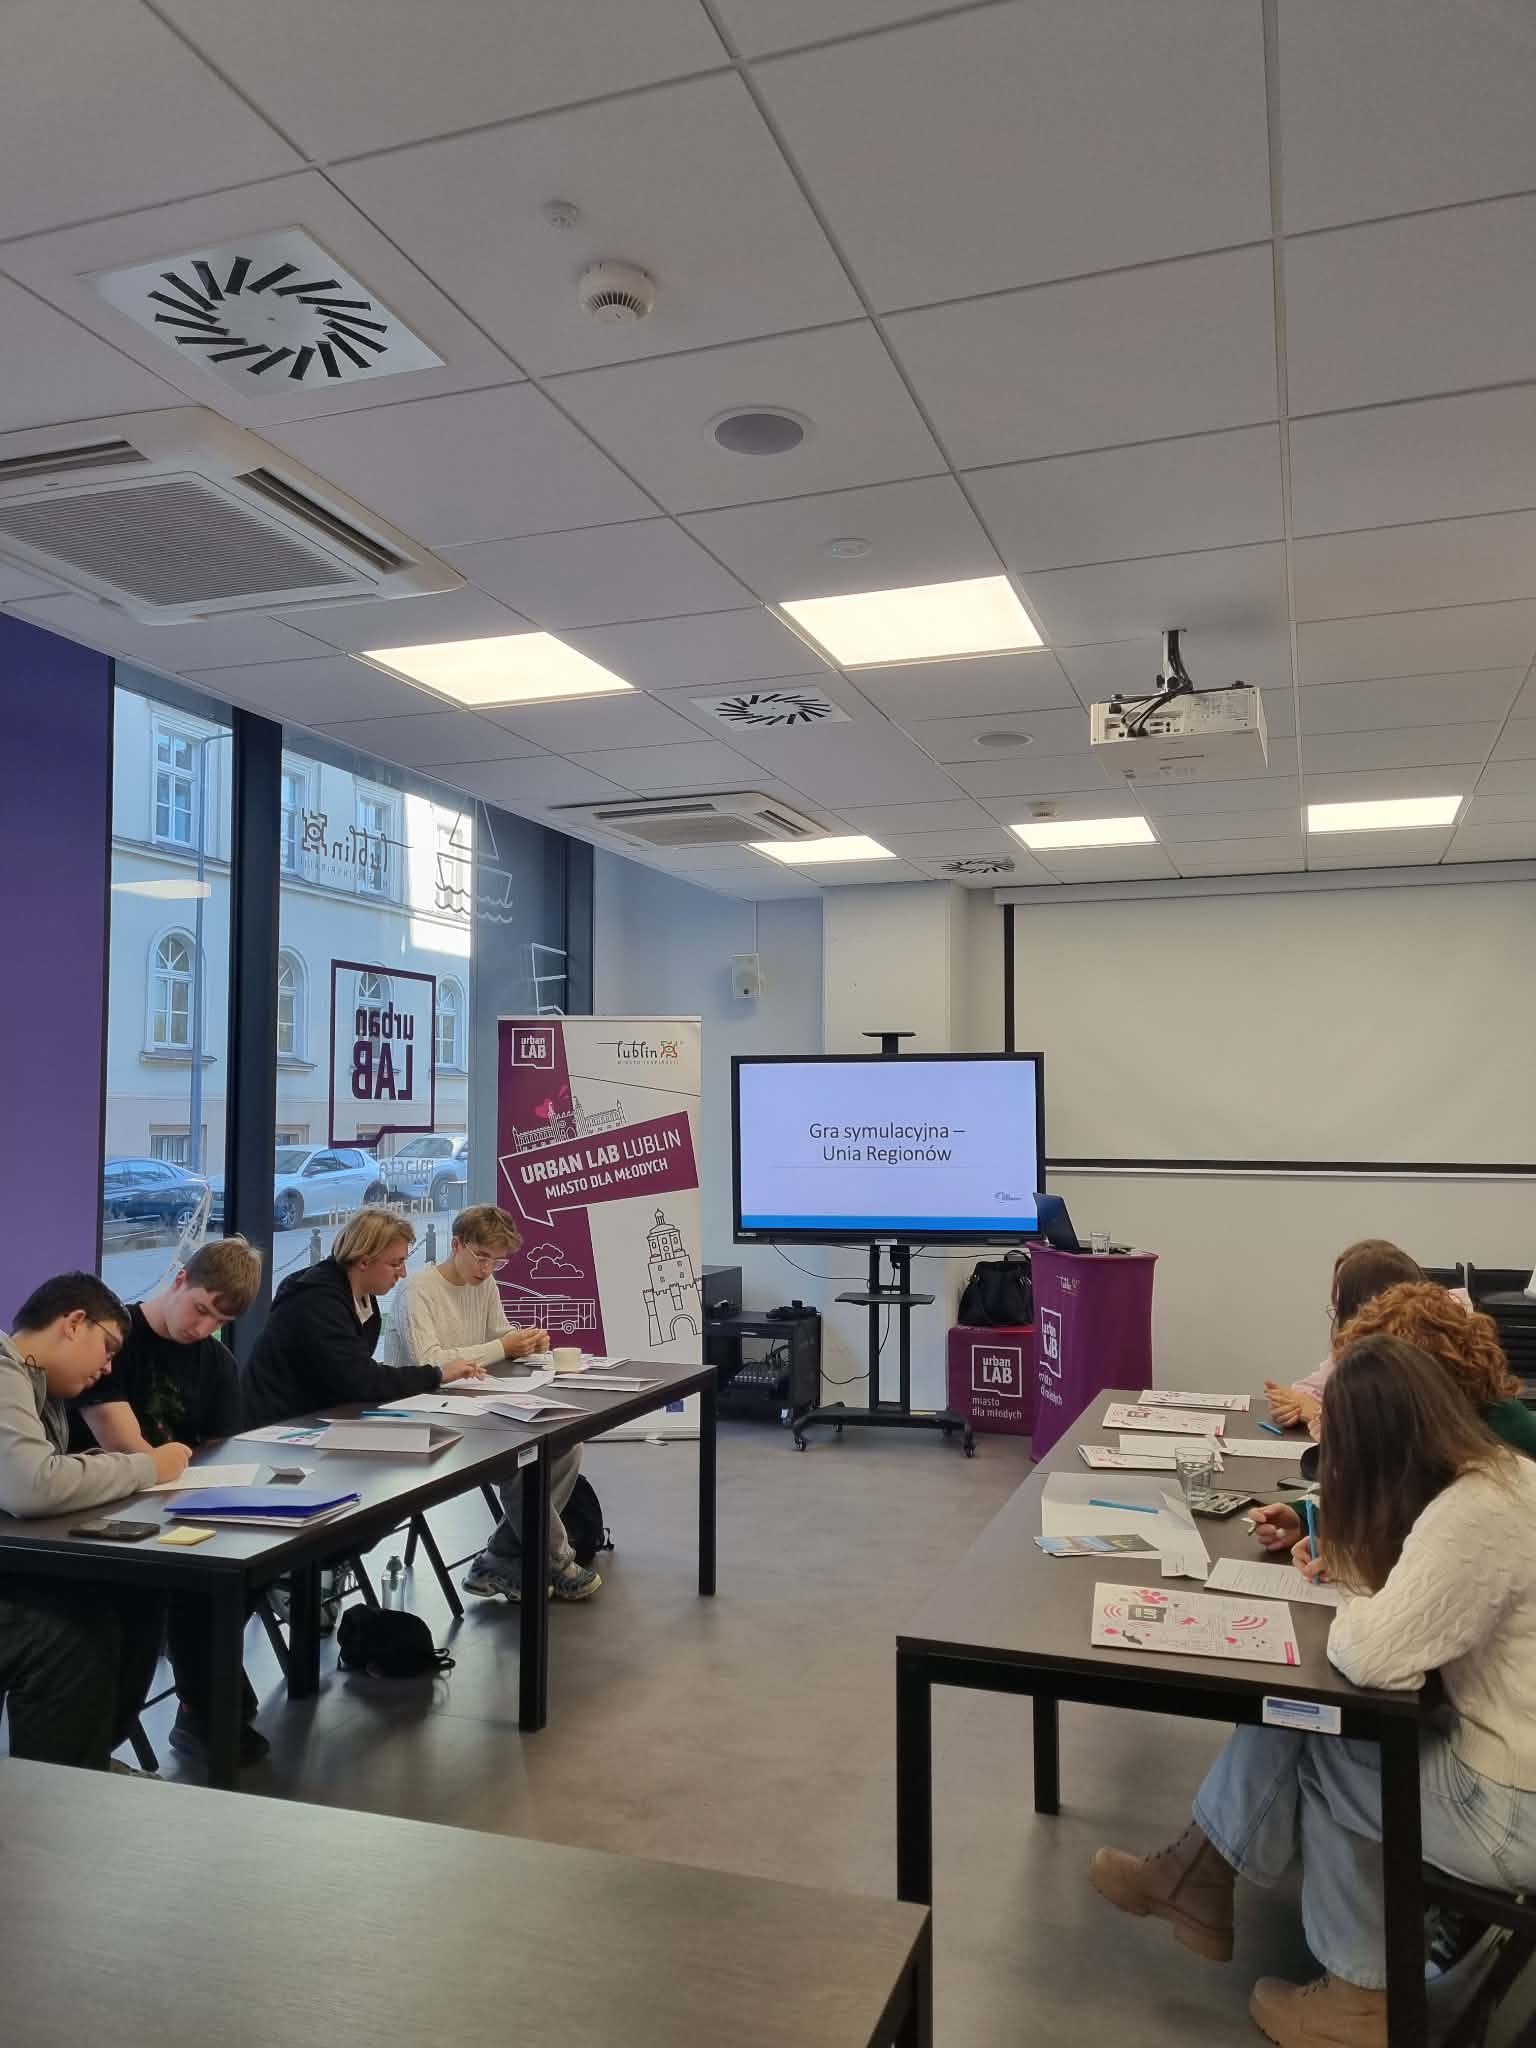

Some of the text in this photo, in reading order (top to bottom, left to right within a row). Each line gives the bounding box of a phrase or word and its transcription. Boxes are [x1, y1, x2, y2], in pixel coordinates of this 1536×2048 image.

[521, 1035, 545, 1045] urban
[600, 1040, 657, 1058] lublin
[521, 1044, 546, 1059] LAB
[809, 1123, 839, 1138] Gra
[844, 1122, 949, 1142] symulacyjna
[521, 1129, 681, 1184] URBAN LAB LUBLIN
[823, 1145, 952, 1165] Unia Regionów
[545, 1157, 668, 1200] MIASTO DLA MŁODYCH
[982, 1354, 1011, 1367] urban
[982, 1366, 1013, 1385] LAB
[972, 1397, 1000, 1407] miasto
[972, 1407, 985, 1417] dla
